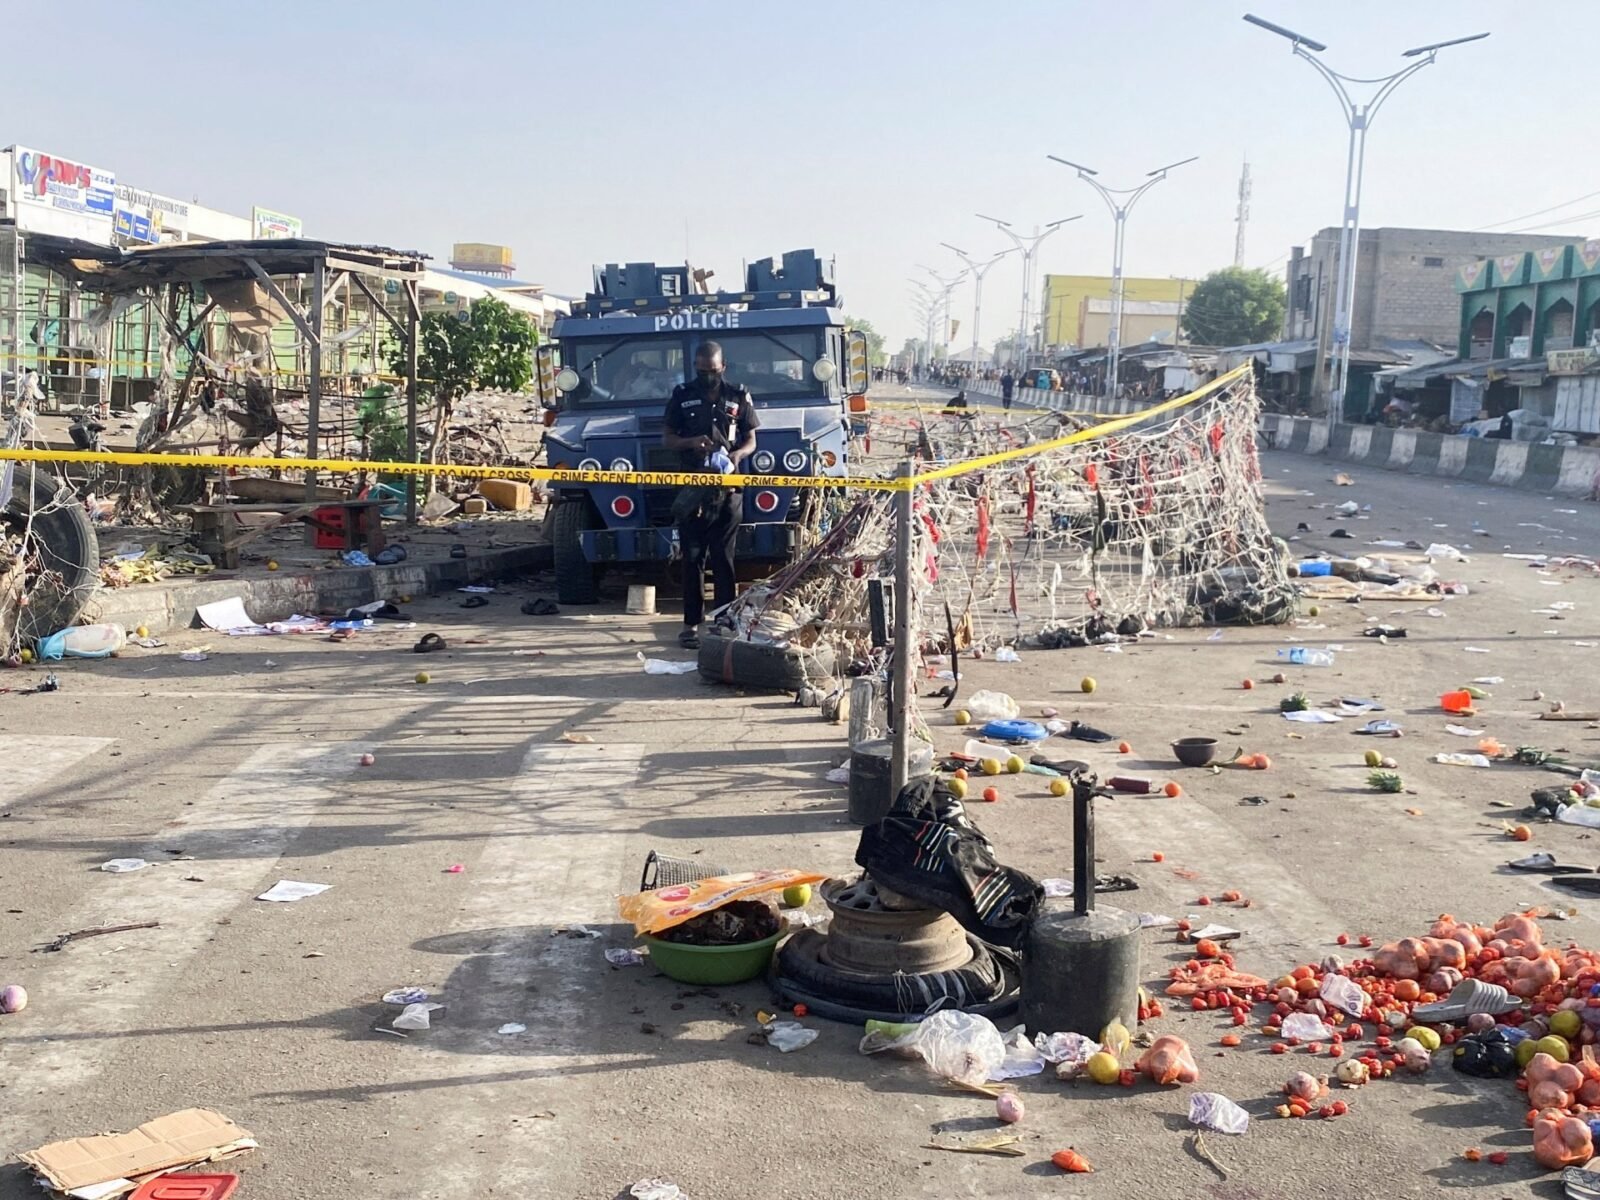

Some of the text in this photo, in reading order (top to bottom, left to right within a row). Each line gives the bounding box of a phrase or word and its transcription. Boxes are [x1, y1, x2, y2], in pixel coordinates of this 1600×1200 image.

[654, 312, 739, 331] POLICE
[460, 470, 485, 478] NOT
[489, 470, 531, 480] CROSS
[551, 471, 723, 486] CRIME SCENE DO NOT CROSS
[742, 476, 779, 486] CRIME
[783, 477, 821, 486] SCENE
